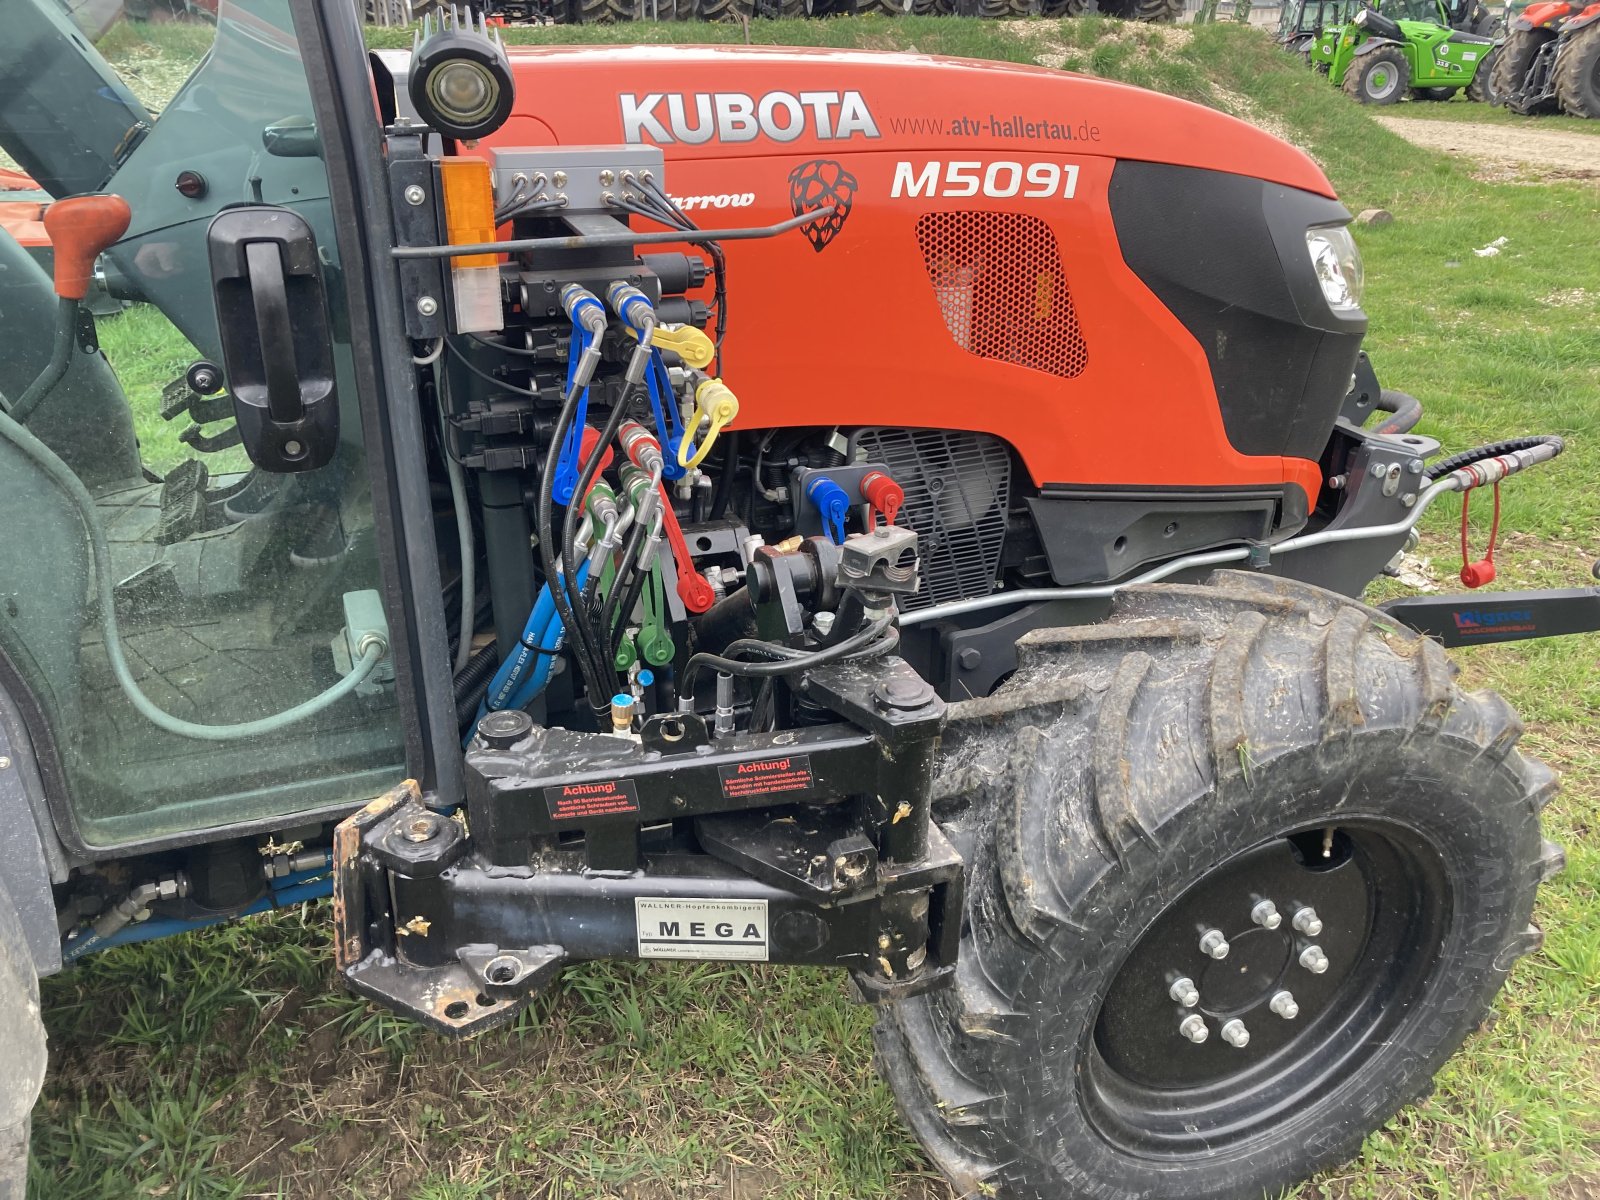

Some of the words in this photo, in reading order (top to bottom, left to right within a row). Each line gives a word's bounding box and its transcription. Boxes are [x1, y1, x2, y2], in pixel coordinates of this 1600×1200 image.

[619, 90, 882, 145] KUBOTA
[889, 114, 1101, 142] www.atv-hallertau.de
[890, 161, 1081, 199] M5091
[737, 758, 791, 774] Achtung!
[563, 782, 616, 796] Achtung!
[658, 921, 762, 939] MEGA
